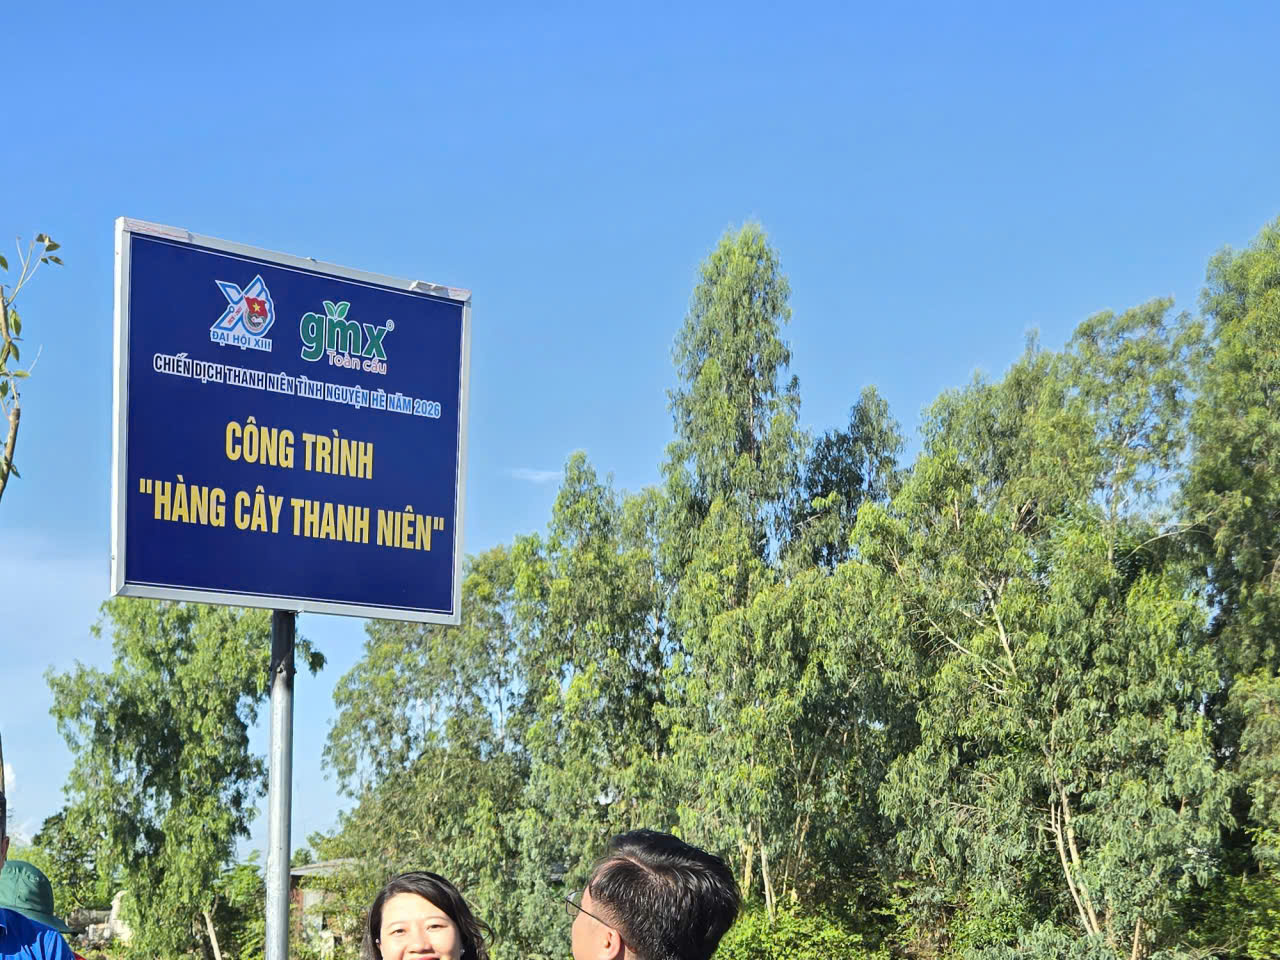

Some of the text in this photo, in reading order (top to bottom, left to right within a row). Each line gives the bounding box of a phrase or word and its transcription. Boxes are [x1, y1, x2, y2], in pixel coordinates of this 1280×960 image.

[212, 331, 271, 351] ĐẠI HỘI XIII
[154, 353, 441, 419] CHIẾN DỊCH THANH NIÊN TÌNH NGUYỆN HÈ NĂM 2026
[225, 416, 374, 479] CÔNG TRÌNH
[139, 474, 445, 551] "HÀNG CÂY THANH NIÊN"
